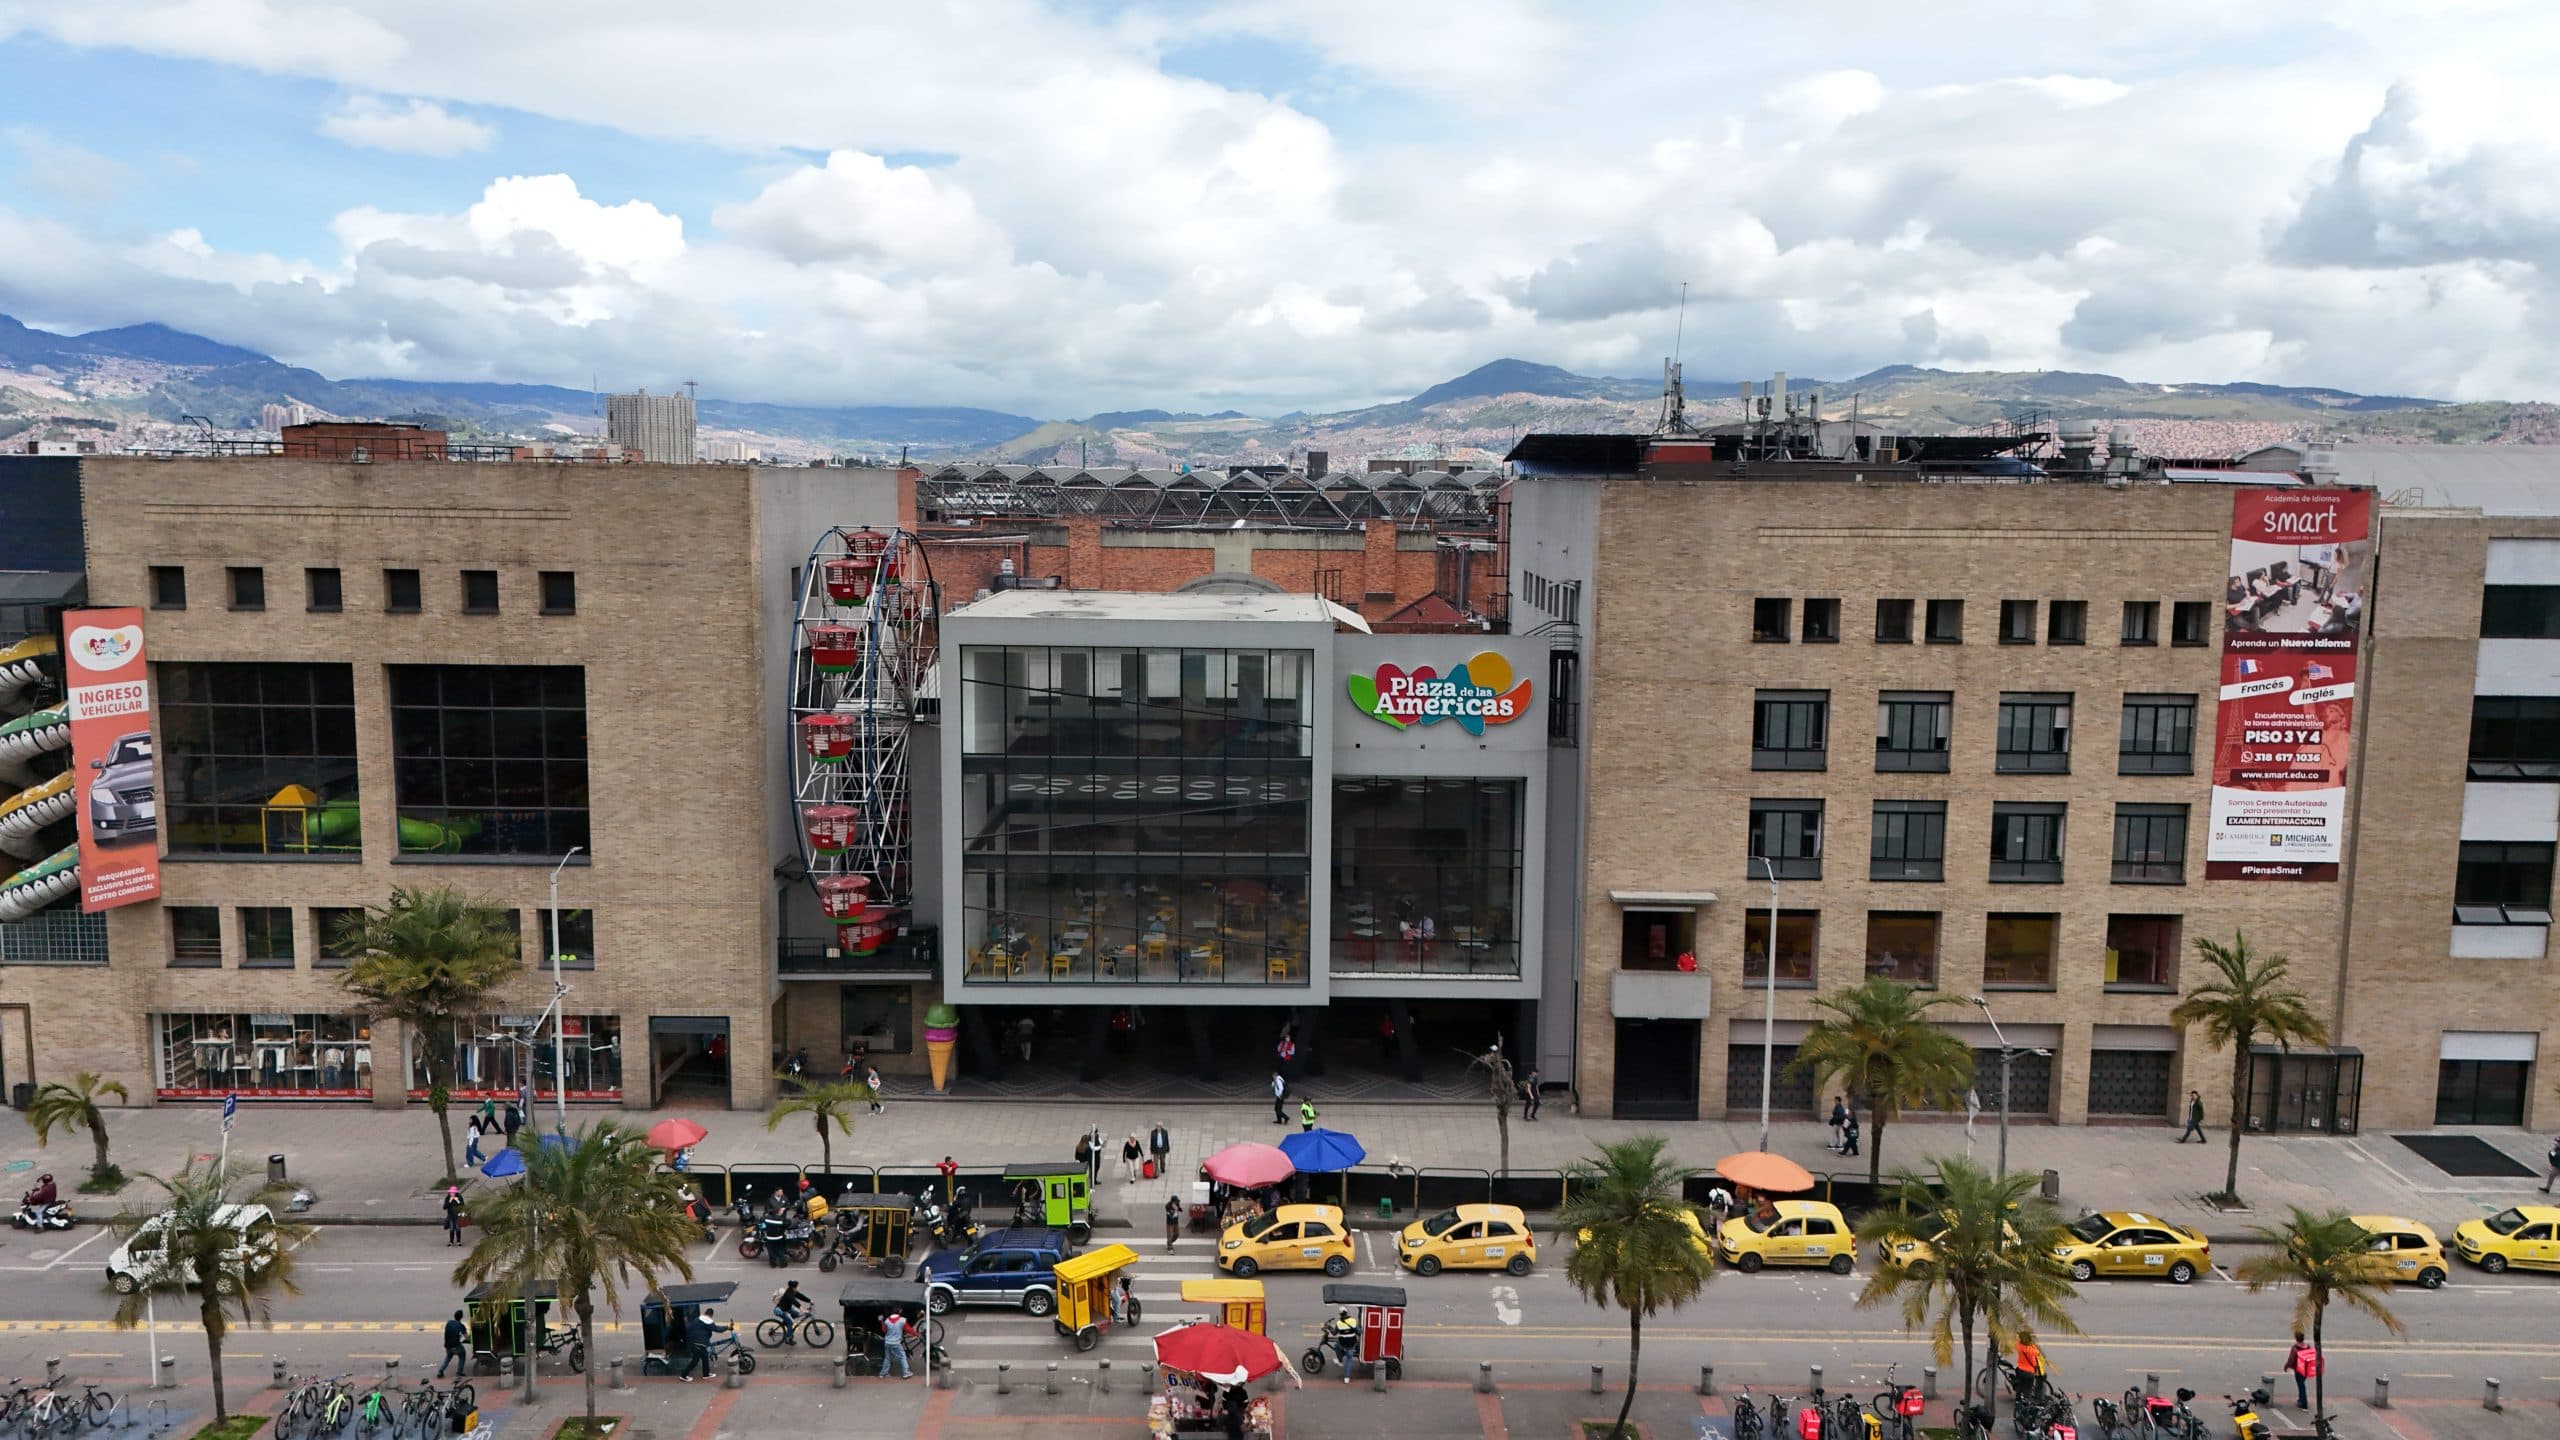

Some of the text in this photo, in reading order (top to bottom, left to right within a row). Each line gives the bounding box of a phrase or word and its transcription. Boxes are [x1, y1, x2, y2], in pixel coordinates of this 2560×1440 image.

[2264, 495, 2299, 503] Academia
[2312, 495, 2340, 503] Idiomas
[2263, 504, 2338, 533] smart
[2230, 639, 2266, 649] Aprende
[2280, 638, 2313, 648] Nuevo
[2315, 638, 2351, 648] Idioma
[1390, 677, 1493, 697] Plaza de las
[2241, 680, 2284, 694] Francés
[80, 686, 142, 705] INGRESO
[2302, 688, 2335, 702] Inglés
[81, 700, 143, 716] VEHICULAR
[1373, 692, 1514, 716] Américas
[2271, 719, 2325, 727] administrativa
[2245, 730, 2320, 743] PISO 3 Y 4
[2254, 753, 2320, 762] 318 617 1036
[2241, 771, 2319, 779] www.smart.edu.co
[2228, 799, 2254, 807] Somos
[2228, 817, 2324, 826] EXAMEN INTERNACIONAL
[2285, 834, 2328, 843] MICHIGAN
[96, 866, 145, 883] PARQUEADERO
[2241, 866, 2302, 875] #PiensaSmart
[87, 873, 155, 894] EXCLUSIVO CLIENTES
[89, 883, 155, 903] CENTRO COMERCIAL
[225, 1097, 234, 1115] P
